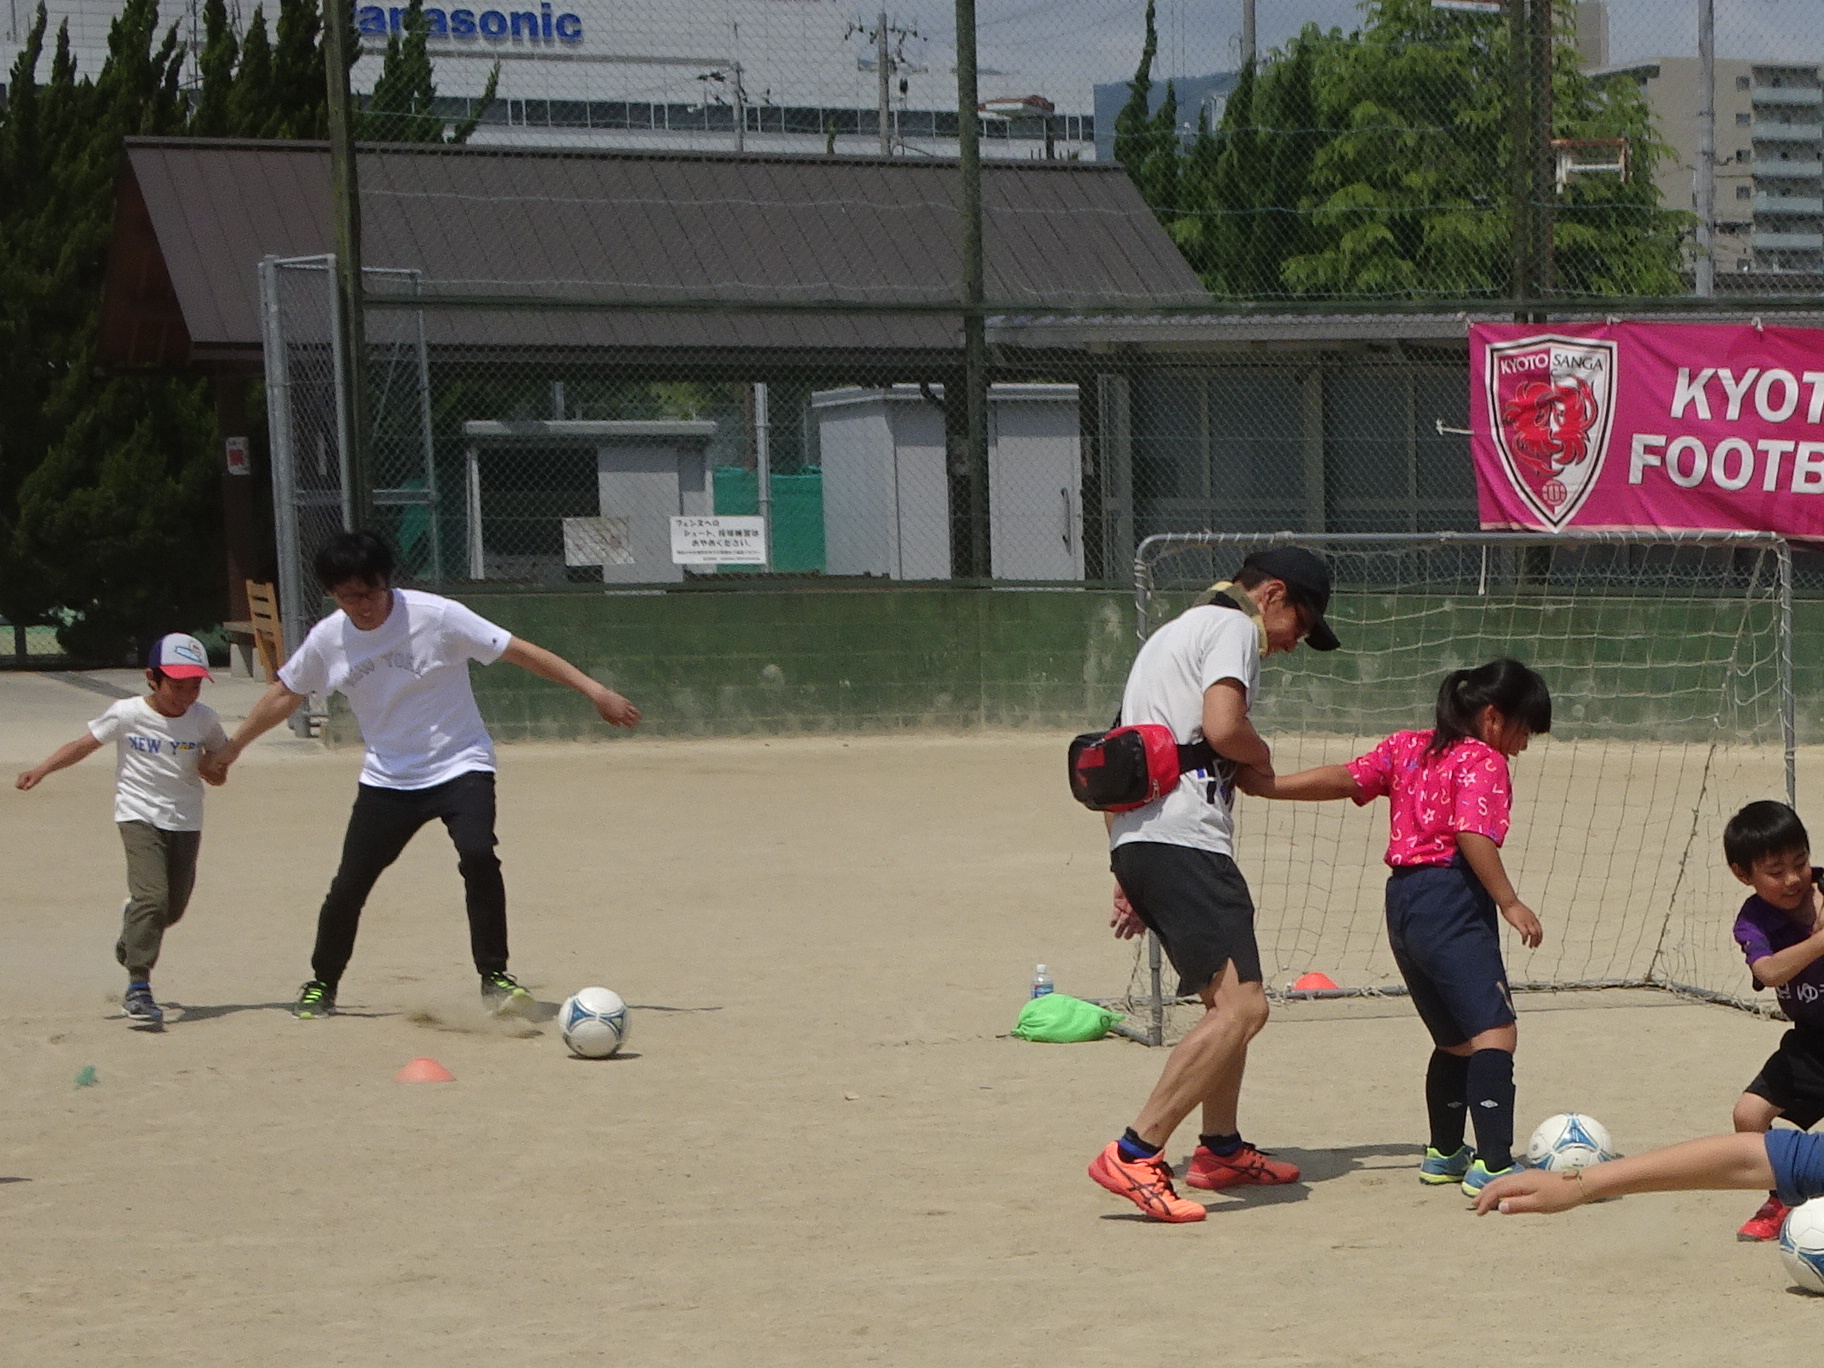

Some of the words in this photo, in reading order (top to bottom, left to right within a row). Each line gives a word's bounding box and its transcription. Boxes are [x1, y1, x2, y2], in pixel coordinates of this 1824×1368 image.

[353, 2, 582, 44] anasonic
[1500, 353, 1549, 375] KYOTO
[1553, 353, 1604, 372] SANGA
